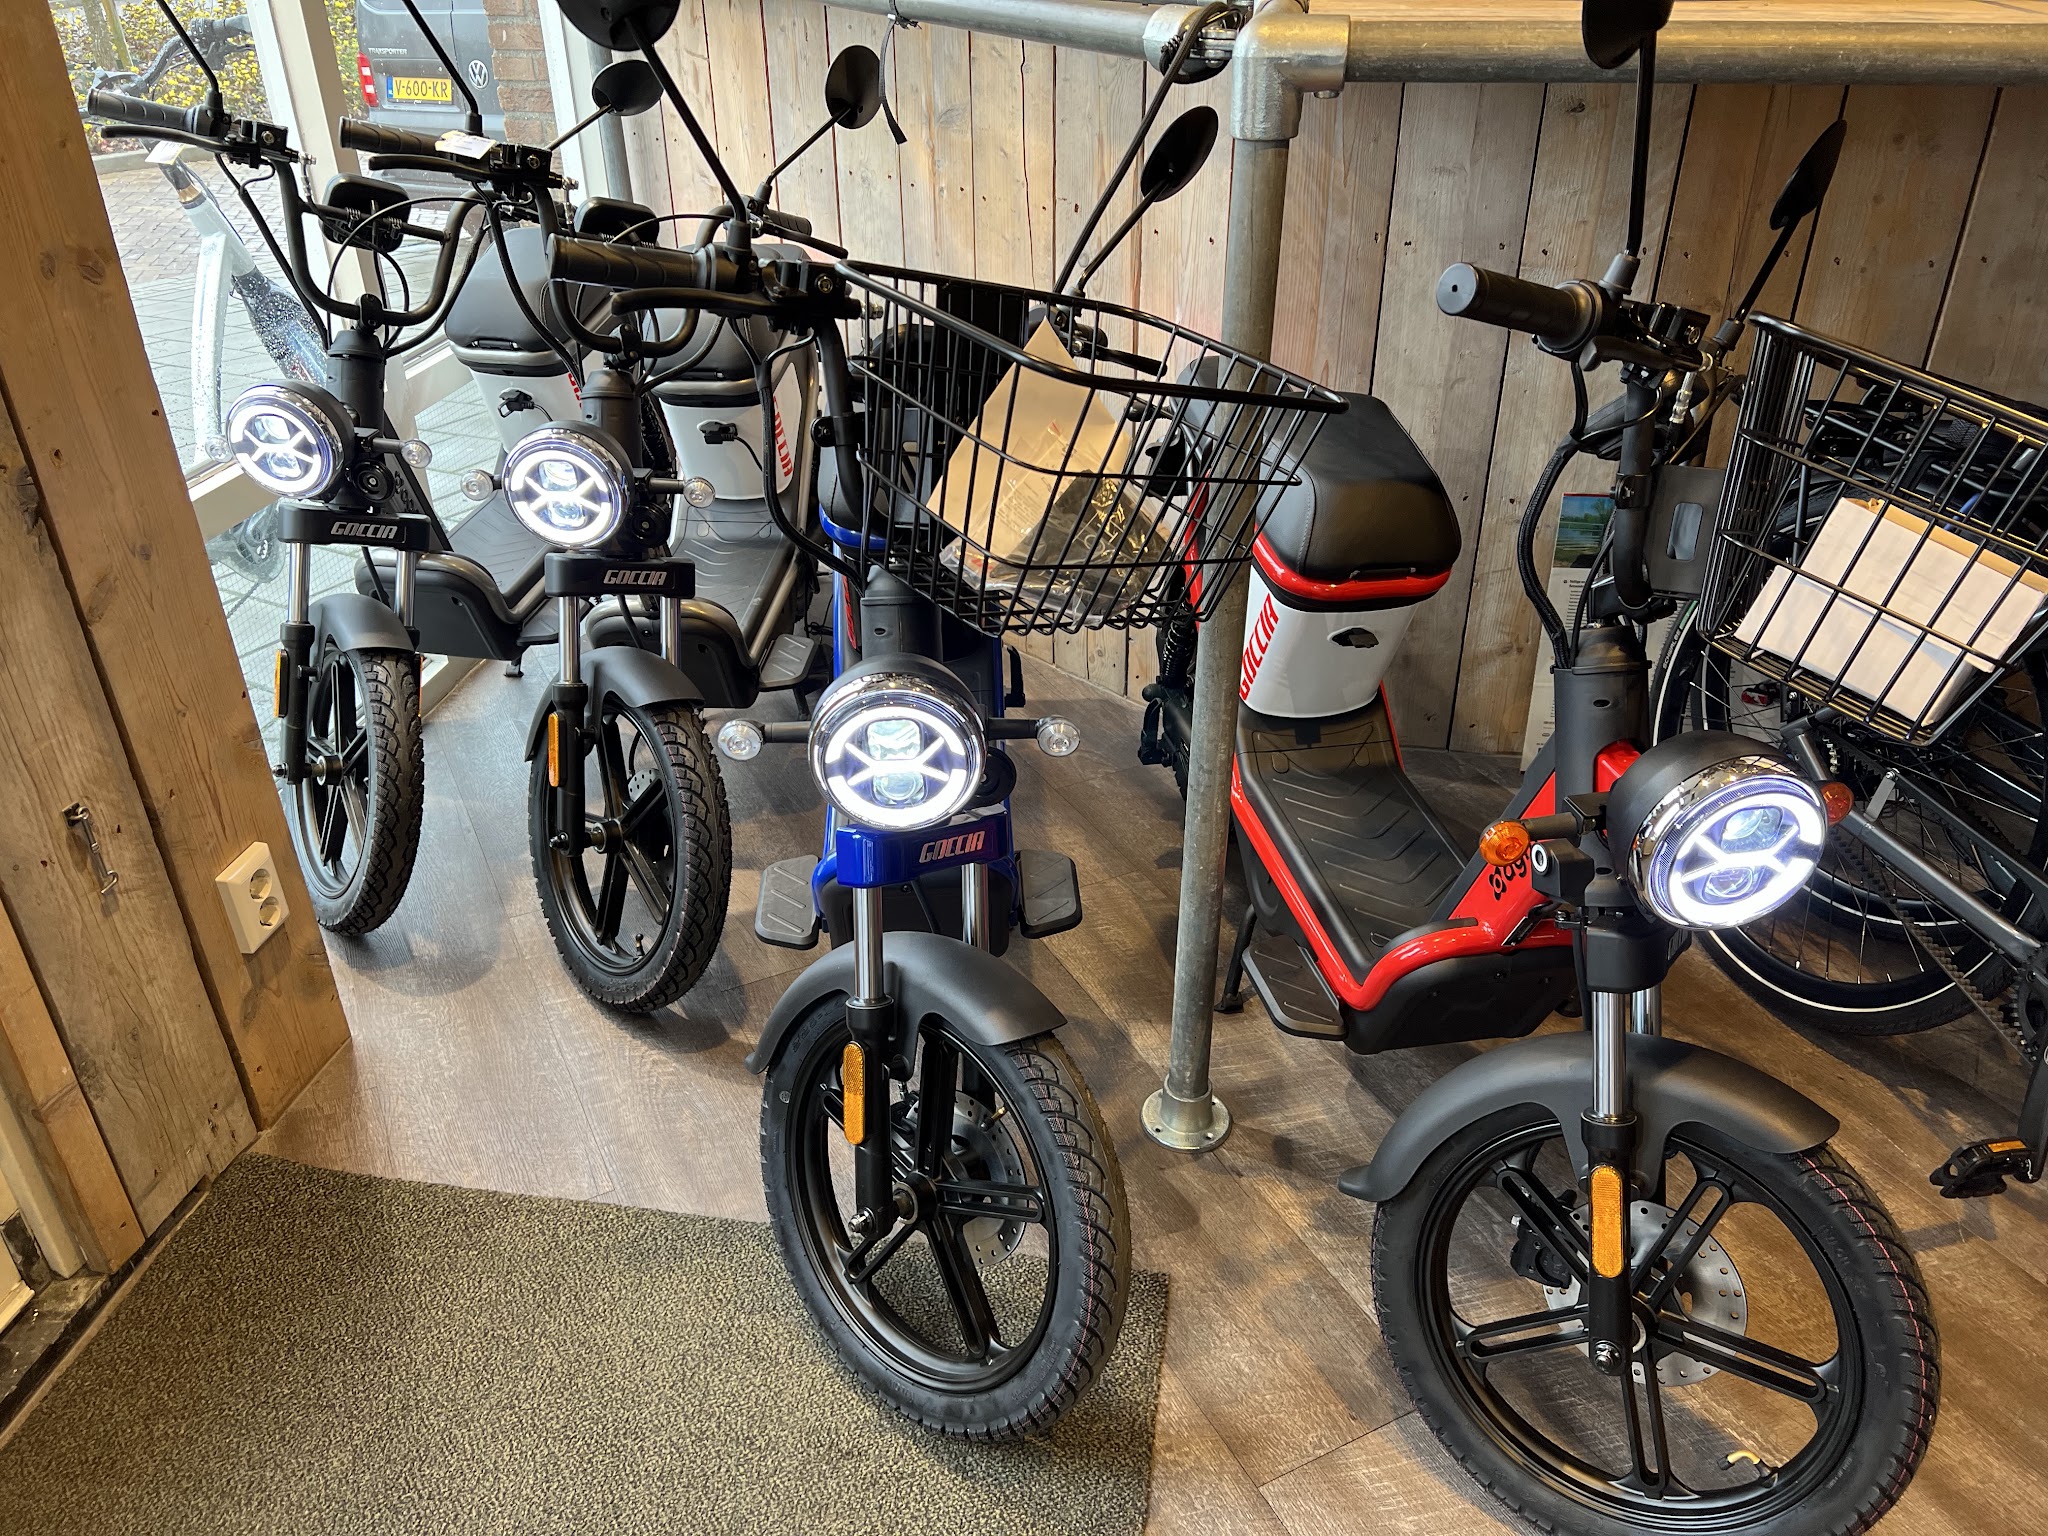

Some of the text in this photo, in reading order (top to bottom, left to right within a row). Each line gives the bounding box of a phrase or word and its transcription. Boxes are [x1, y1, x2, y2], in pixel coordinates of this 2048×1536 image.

[368, 47, 408, 55] TRANSPORTER
[395, 79, 448, 98] V-600-KR
[773, 395, 794, 478] OCCIA
[330, 521, 398, 540] GOCCIA
[603, 569, 667, 586] GOCCIA
[918, 830, 986, 864] GOCCIA
